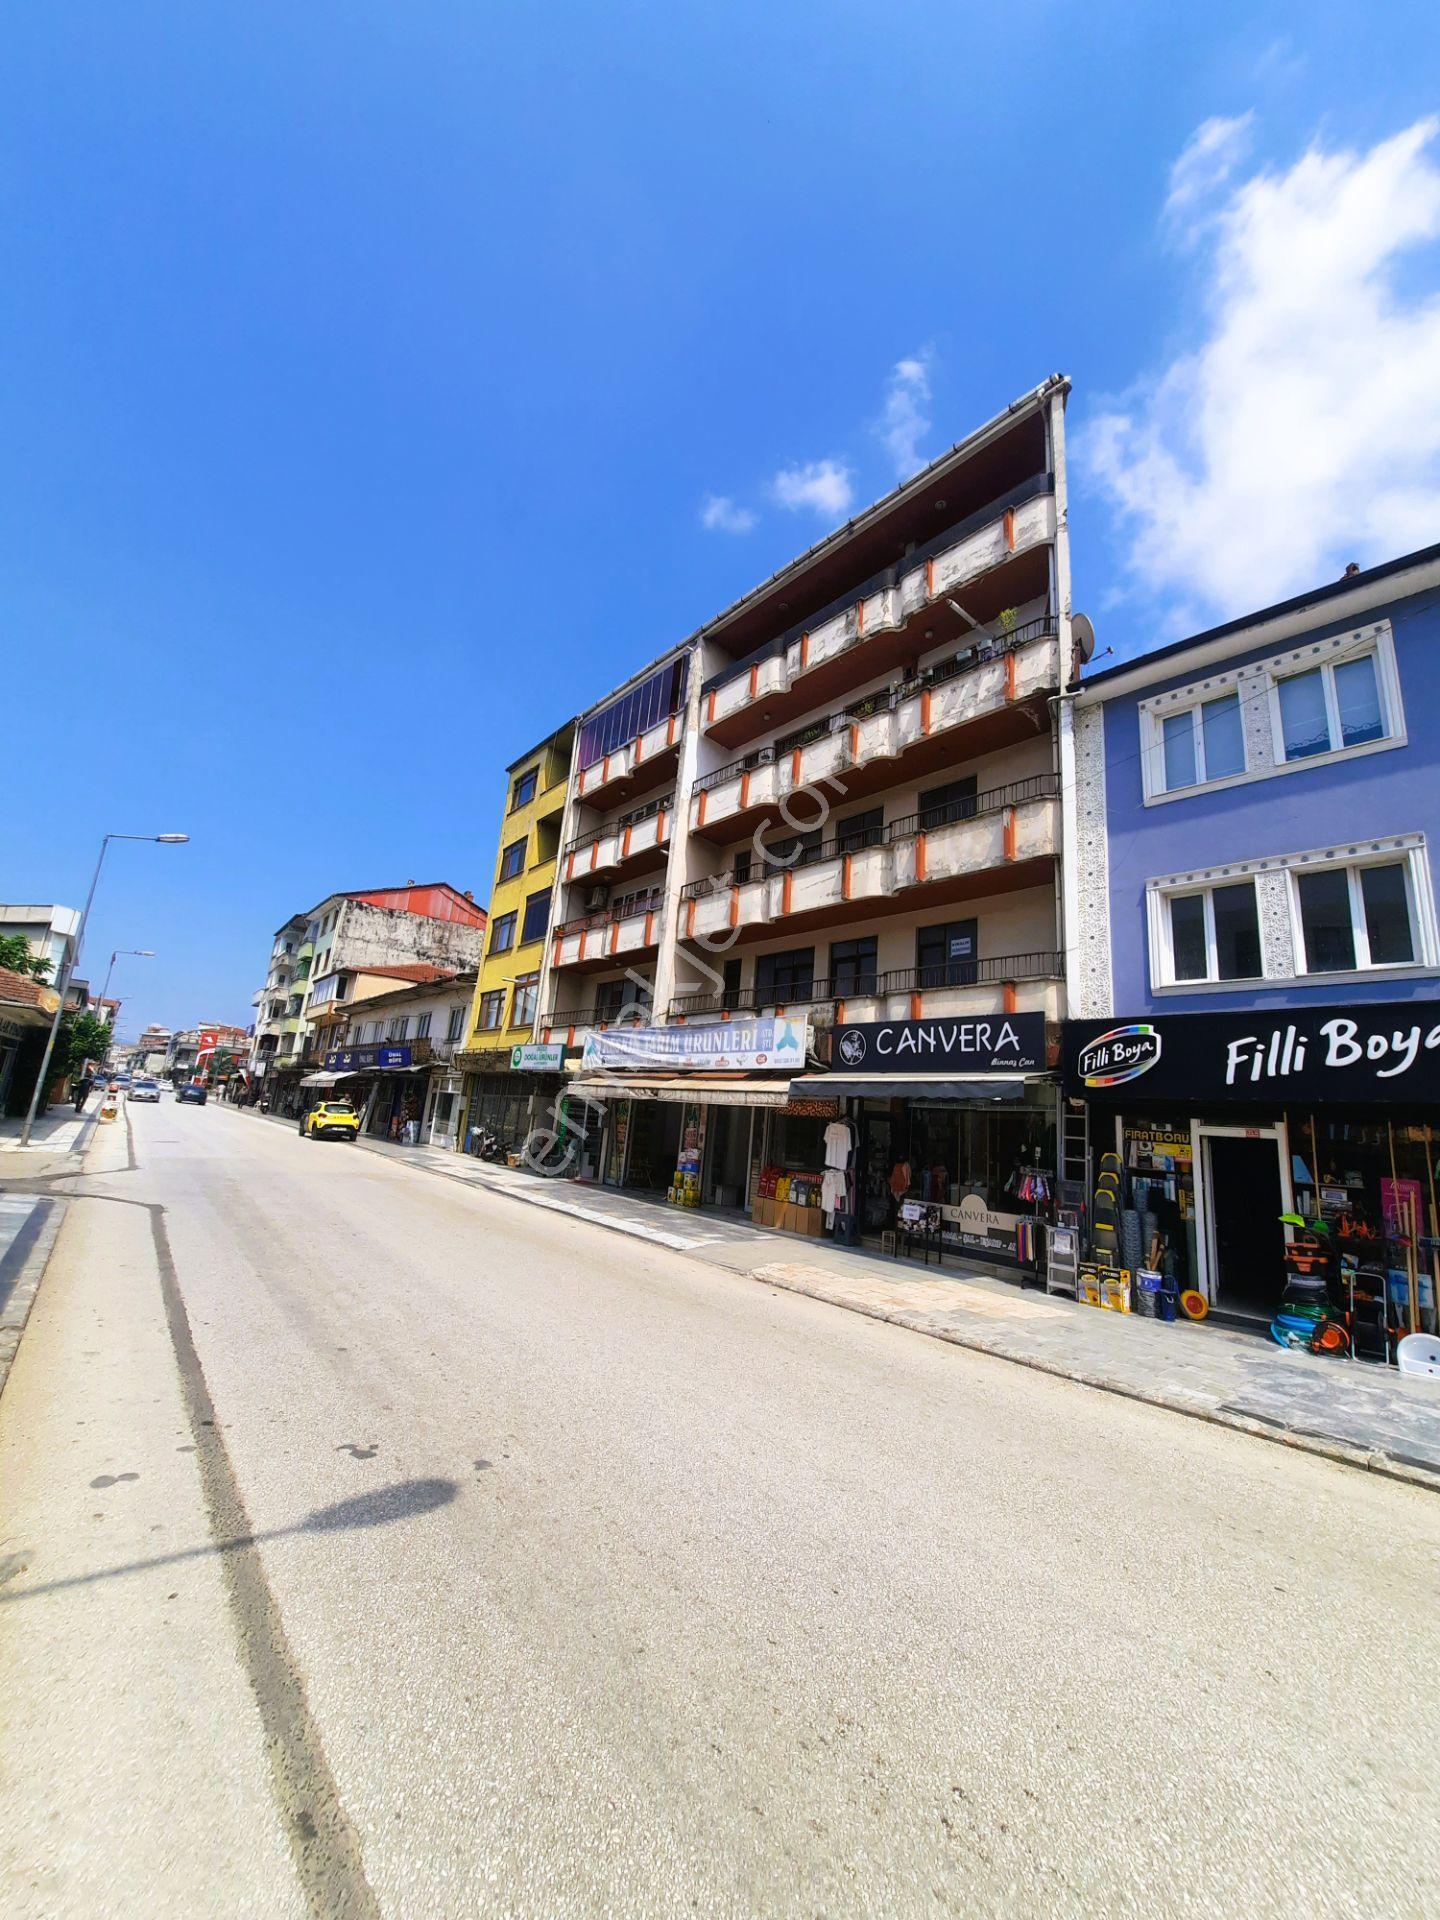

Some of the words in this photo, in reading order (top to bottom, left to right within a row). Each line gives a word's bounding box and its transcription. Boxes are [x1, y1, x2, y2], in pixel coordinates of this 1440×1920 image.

[876, 1021, 1020, 1055] CANVERA
[1018, 1057, 1035, 1067] Can
[1084, 1046, 1110, 1073] Filli
[1112, 1042, 1154, 1064] Boya
[1226, 1025, 1308, 1085] Filli
[1124, 1129, 1190, 1143] FIRATBORU
[950, 1208, 1000, 1225] CANVERA
